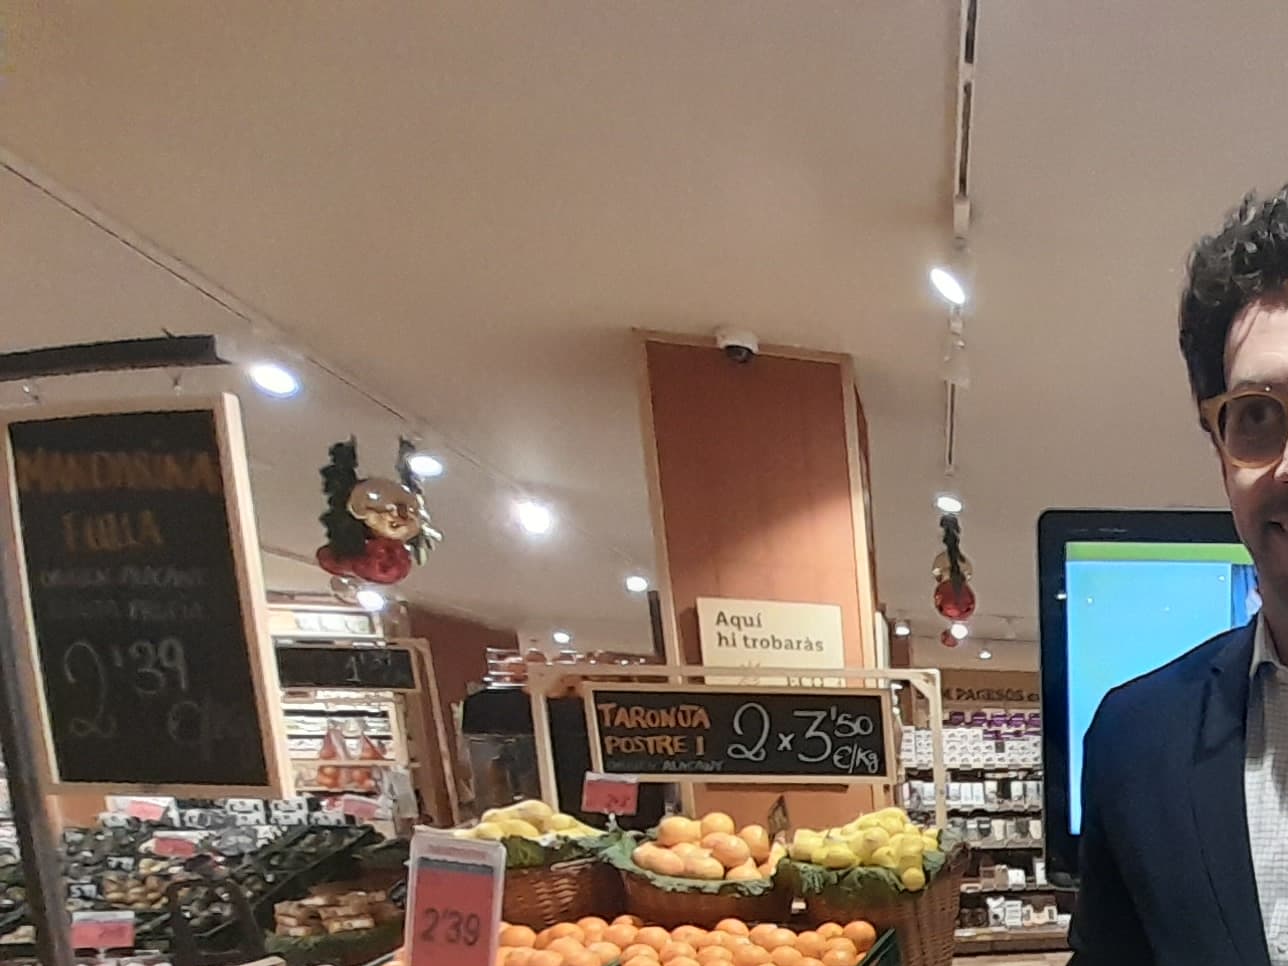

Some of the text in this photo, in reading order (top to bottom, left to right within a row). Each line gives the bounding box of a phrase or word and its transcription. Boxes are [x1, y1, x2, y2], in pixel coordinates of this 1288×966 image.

[714, 610, 763, 630] Aquí
[716, 632, 825, 653] hi trobaràs
[605, 734, 689, 755] POSTRE
[421, 907, 481, 947] 2'39
